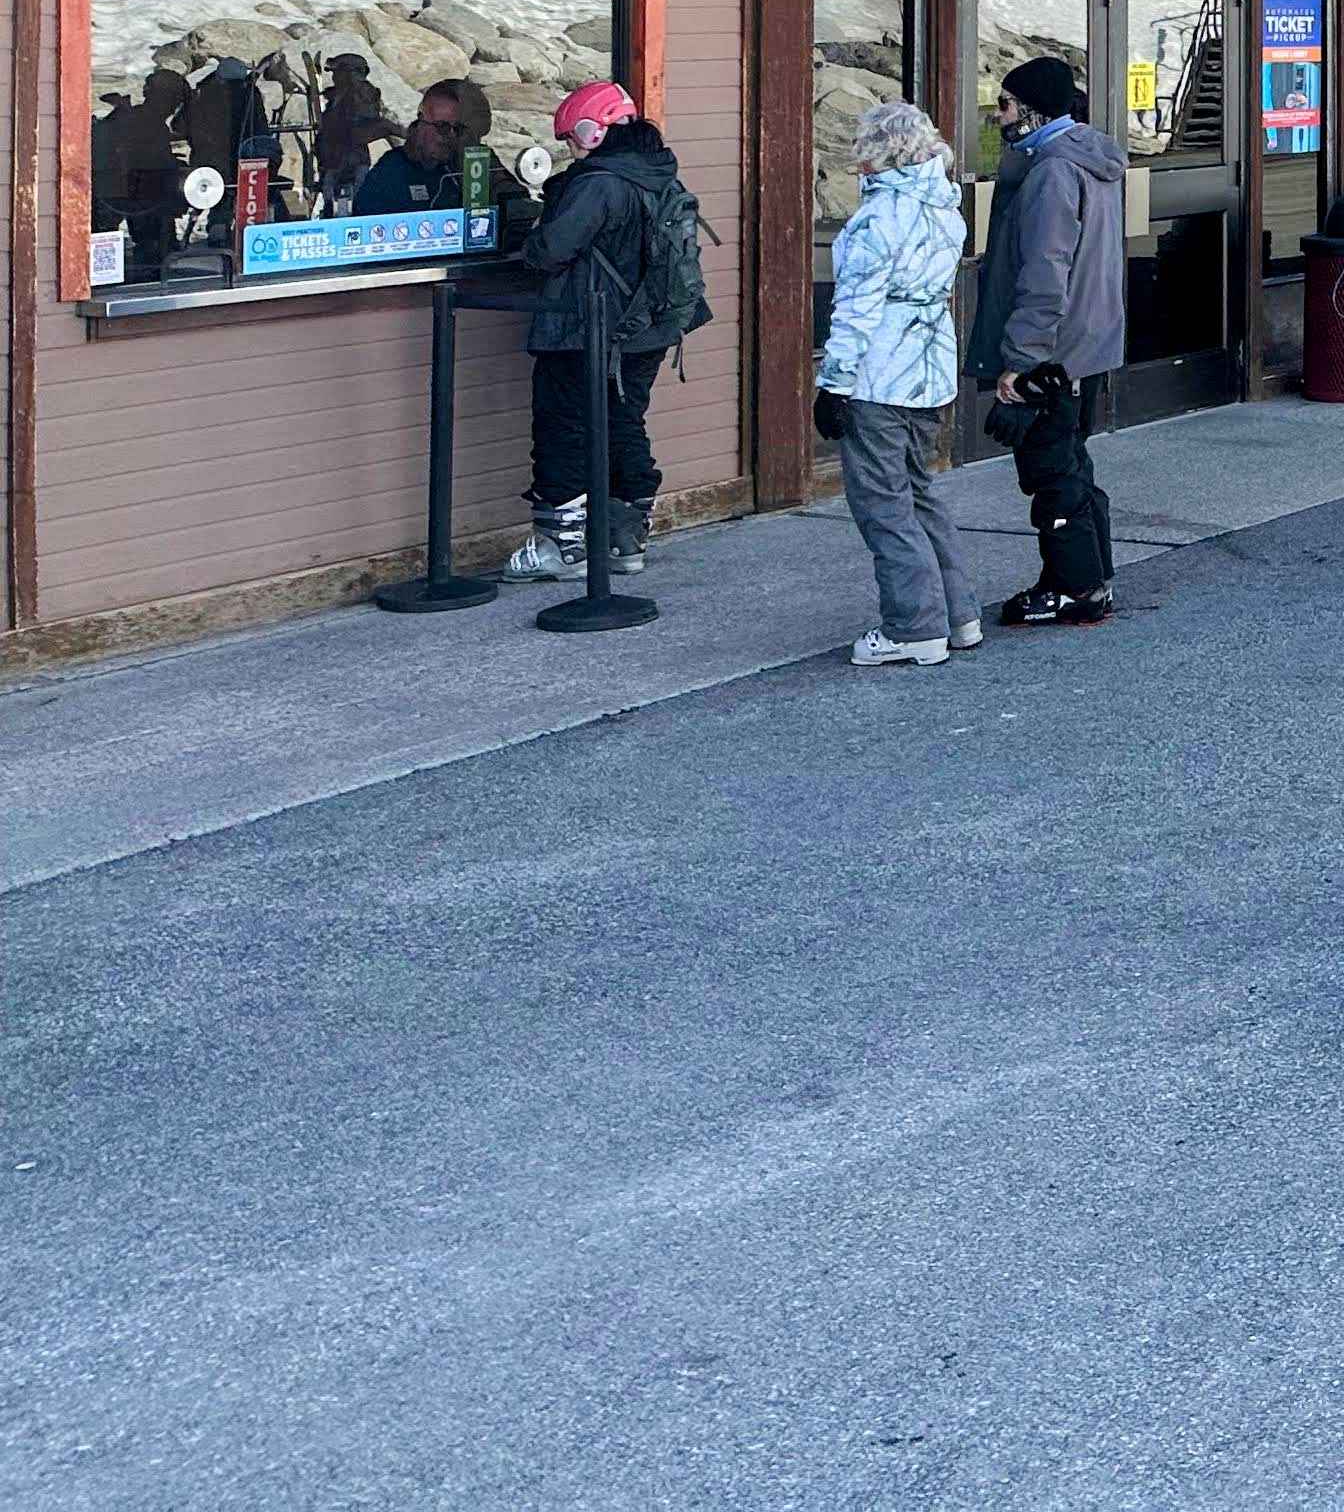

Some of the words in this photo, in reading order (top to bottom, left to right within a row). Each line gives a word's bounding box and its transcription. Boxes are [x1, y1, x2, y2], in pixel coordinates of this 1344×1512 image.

[1265, 16, 1315, 33] TICKET
[1273, 33, 1307, 42] PICKUP
[282, 233, 330, 248] TICKETS
[281, 251, 290, 262] &
[293, 245, 337, 260] PASSES
